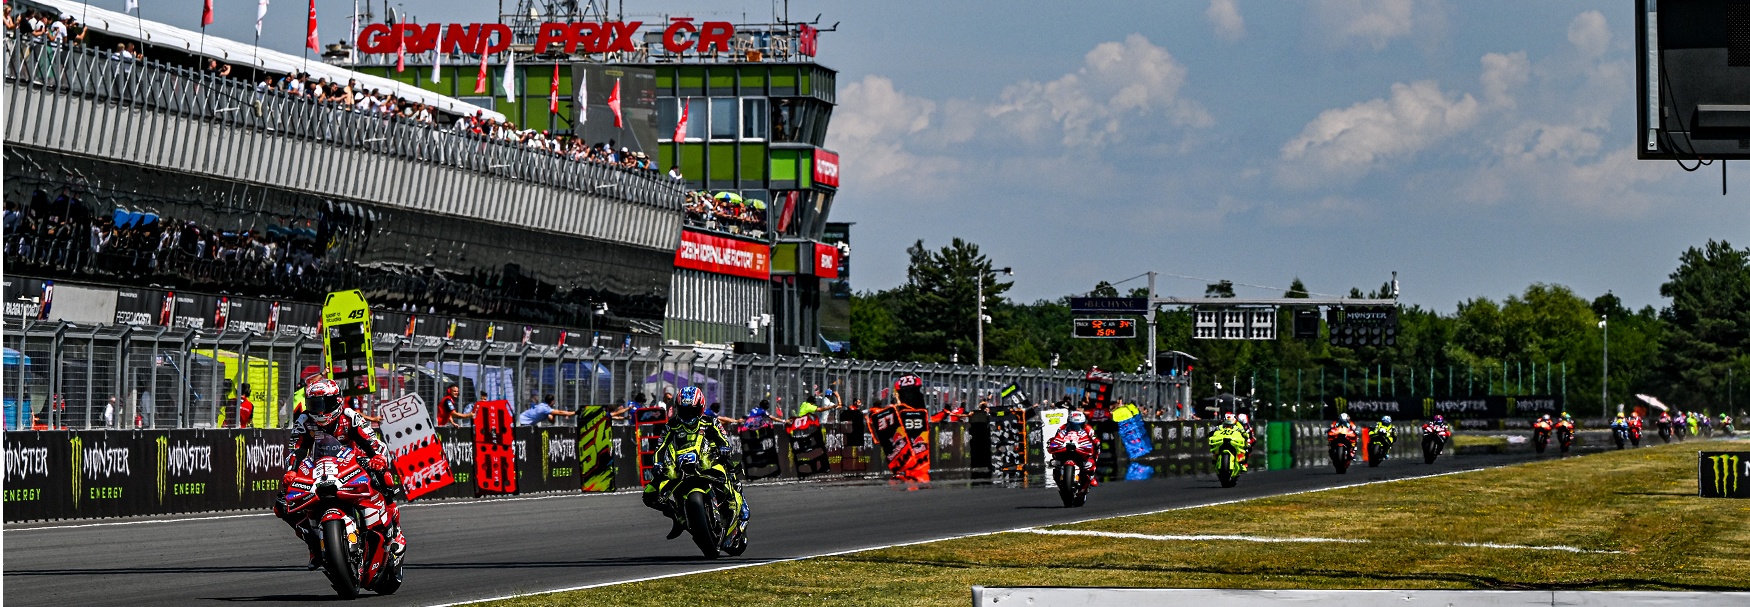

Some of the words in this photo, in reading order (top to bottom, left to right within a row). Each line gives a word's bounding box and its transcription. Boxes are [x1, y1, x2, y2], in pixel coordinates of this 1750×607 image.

[357, 22, 513, 54] GRAND
[535, 21, 643, 53] PRIX
[348, 308, 365, 320] 49
[1347, 311, 1387, 319] MONSTER
[900, 375, 915, 387] 23
[382, 395, 419, 425] 63
[1348, 400, 1400, 412] MONSTER
[1436, 399, 1488, 411] MONSTER
[878, 413, 894, 430] 37
[579, 420, 612, 474] 54
[83, 440, 130, 480] MONSTER
[168, 439, 212, 477] MONSTER
[246, 438, 285, 474] MONSTER
[341, 469, 361, 483] Lenovo
[174, 483, 206, 495] ENERGY
[252, 479, 279, 491] ENERGY
[291, 481, 311, 490] Lenovo
[3, 488, 41, 502] ENERGY
[90, 487, 123, 499] ENERGY
